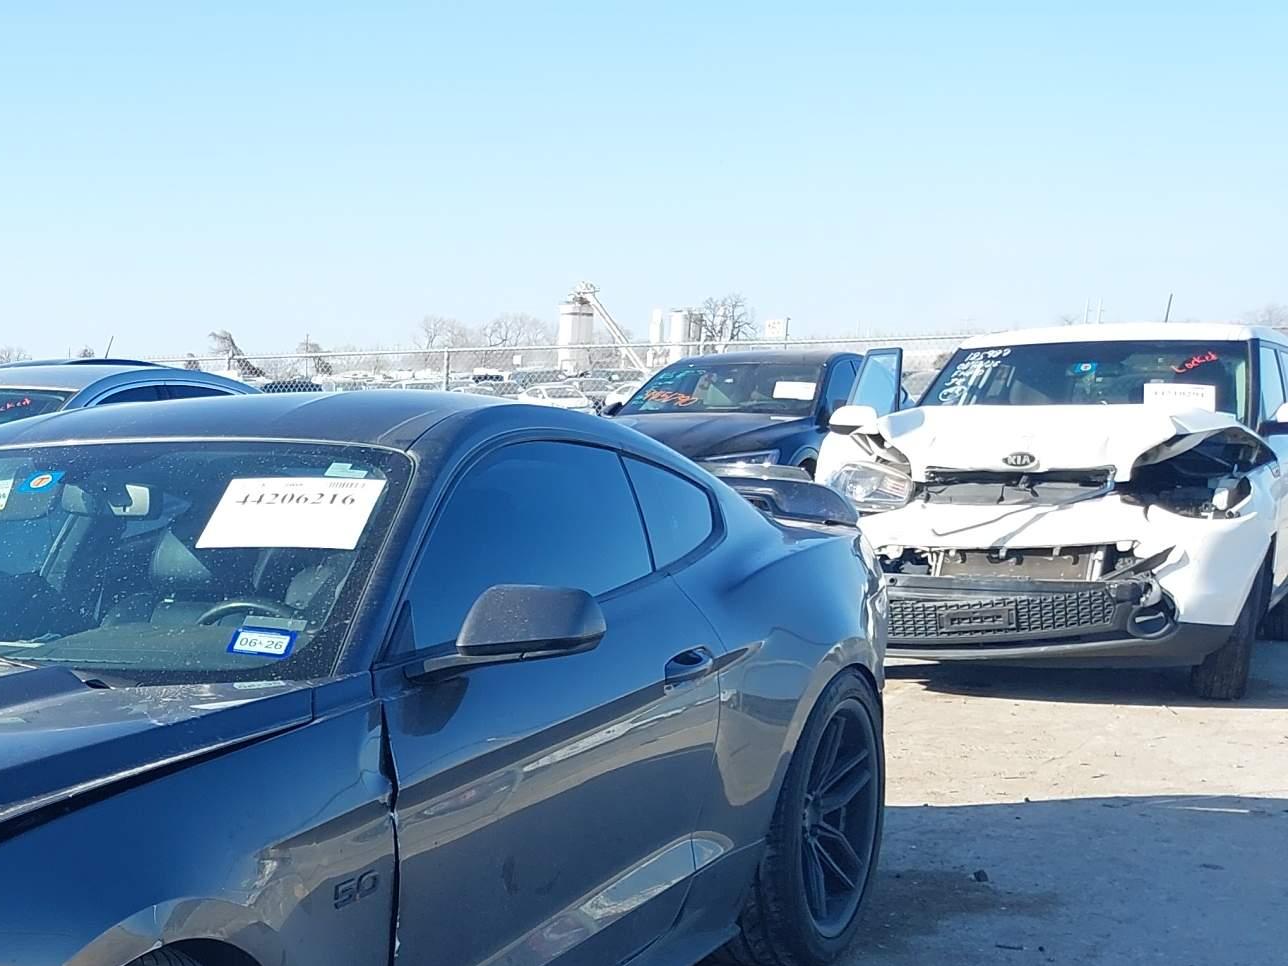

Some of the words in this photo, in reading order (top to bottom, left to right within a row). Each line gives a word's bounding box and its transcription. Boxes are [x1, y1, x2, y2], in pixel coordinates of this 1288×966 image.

[1007, 455, 1031, 465] KIA
[235, 492, 356, 506] 44206216
[239, 637, 259, 647] 06
[264, 640, 284, 650] 26
